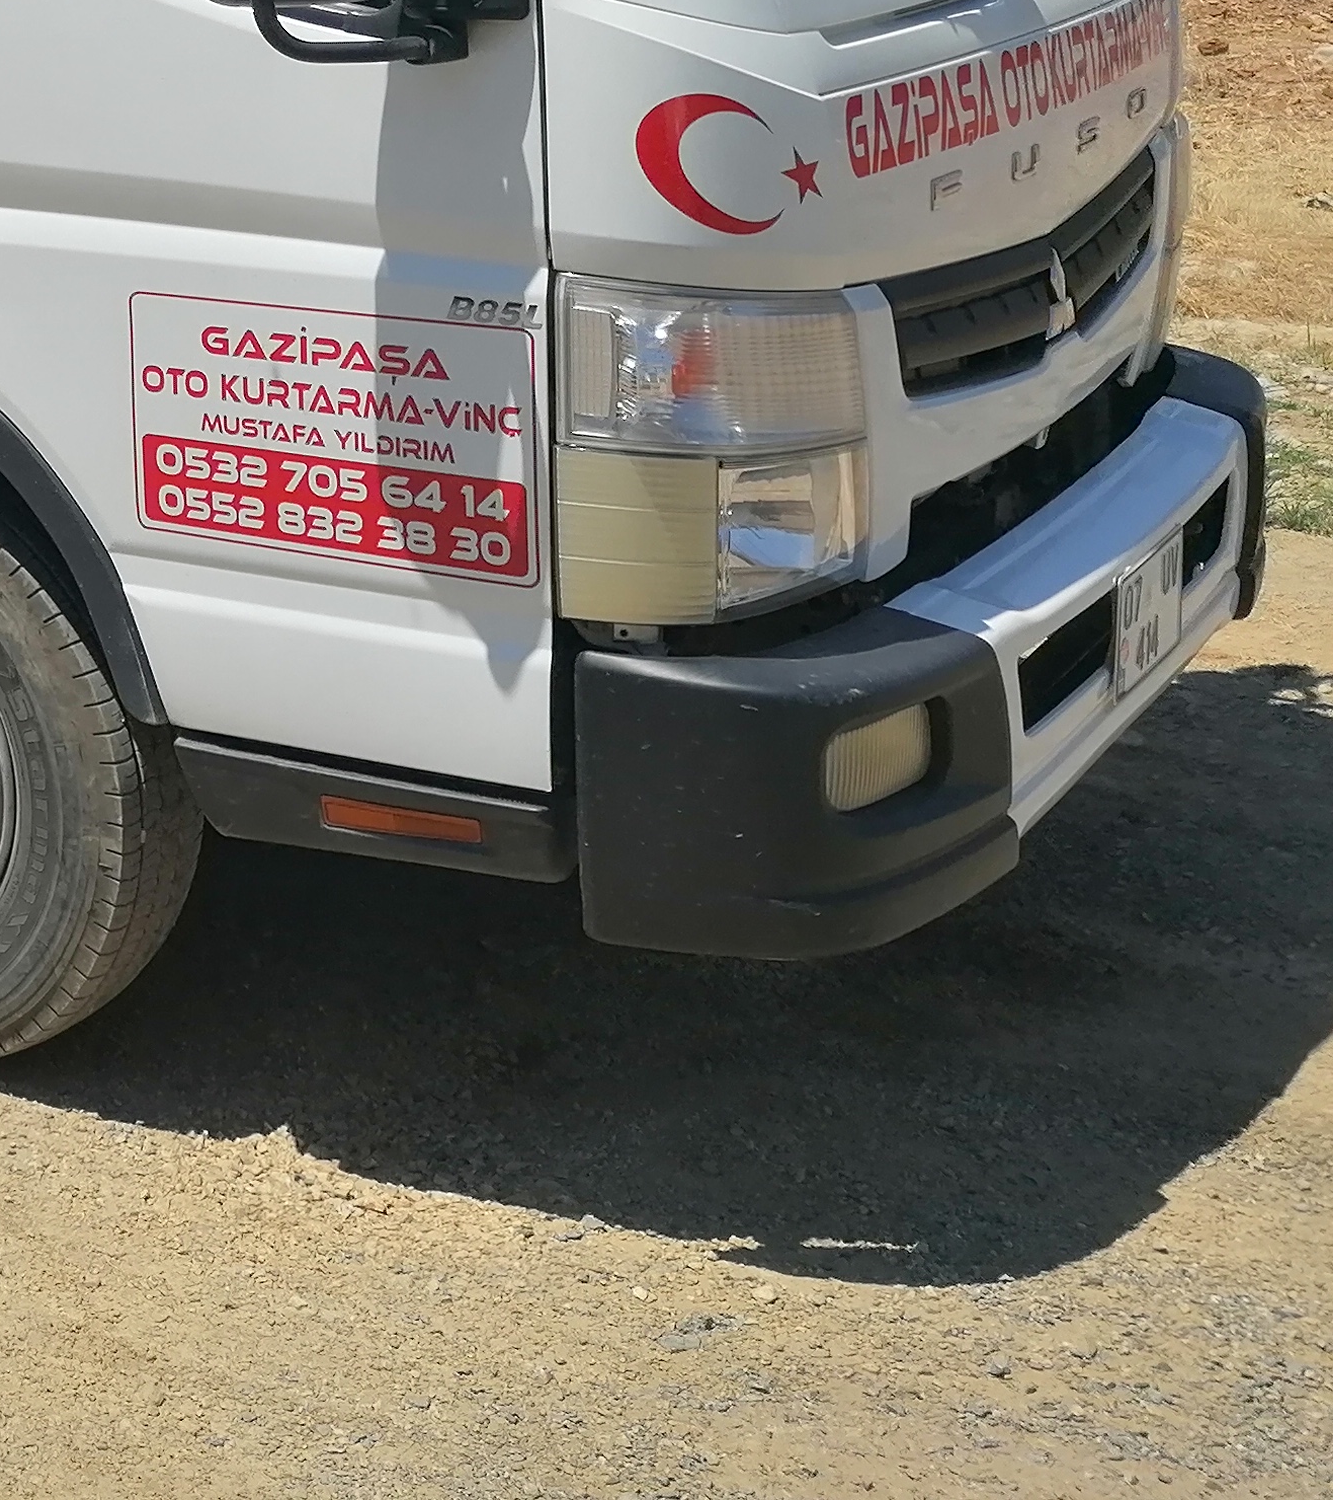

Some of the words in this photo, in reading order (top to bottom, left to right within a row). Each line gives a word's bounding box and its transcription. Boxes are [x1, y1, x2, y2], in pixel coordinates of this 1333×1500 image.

[930, 86, 1148, 212] FUSO
[446, 295, 543, 330] B85L
[142, 365, 209, 399] OTO
[200, 412, 326, 448] MUSTAFA
[333, 429, 456, 464] YILDIRIM
[155, 443, 268, 489] 0532
[280, 460, 368, 503] 705
[380, 475, 448, 514] 64
[460, 484, 511, 522] 14
[158, 484, 266, 530] 0552
[276, 501, 364, 545] 832
[376, 515, 437, 556] 38
[449, 526, 511, 567] 30
